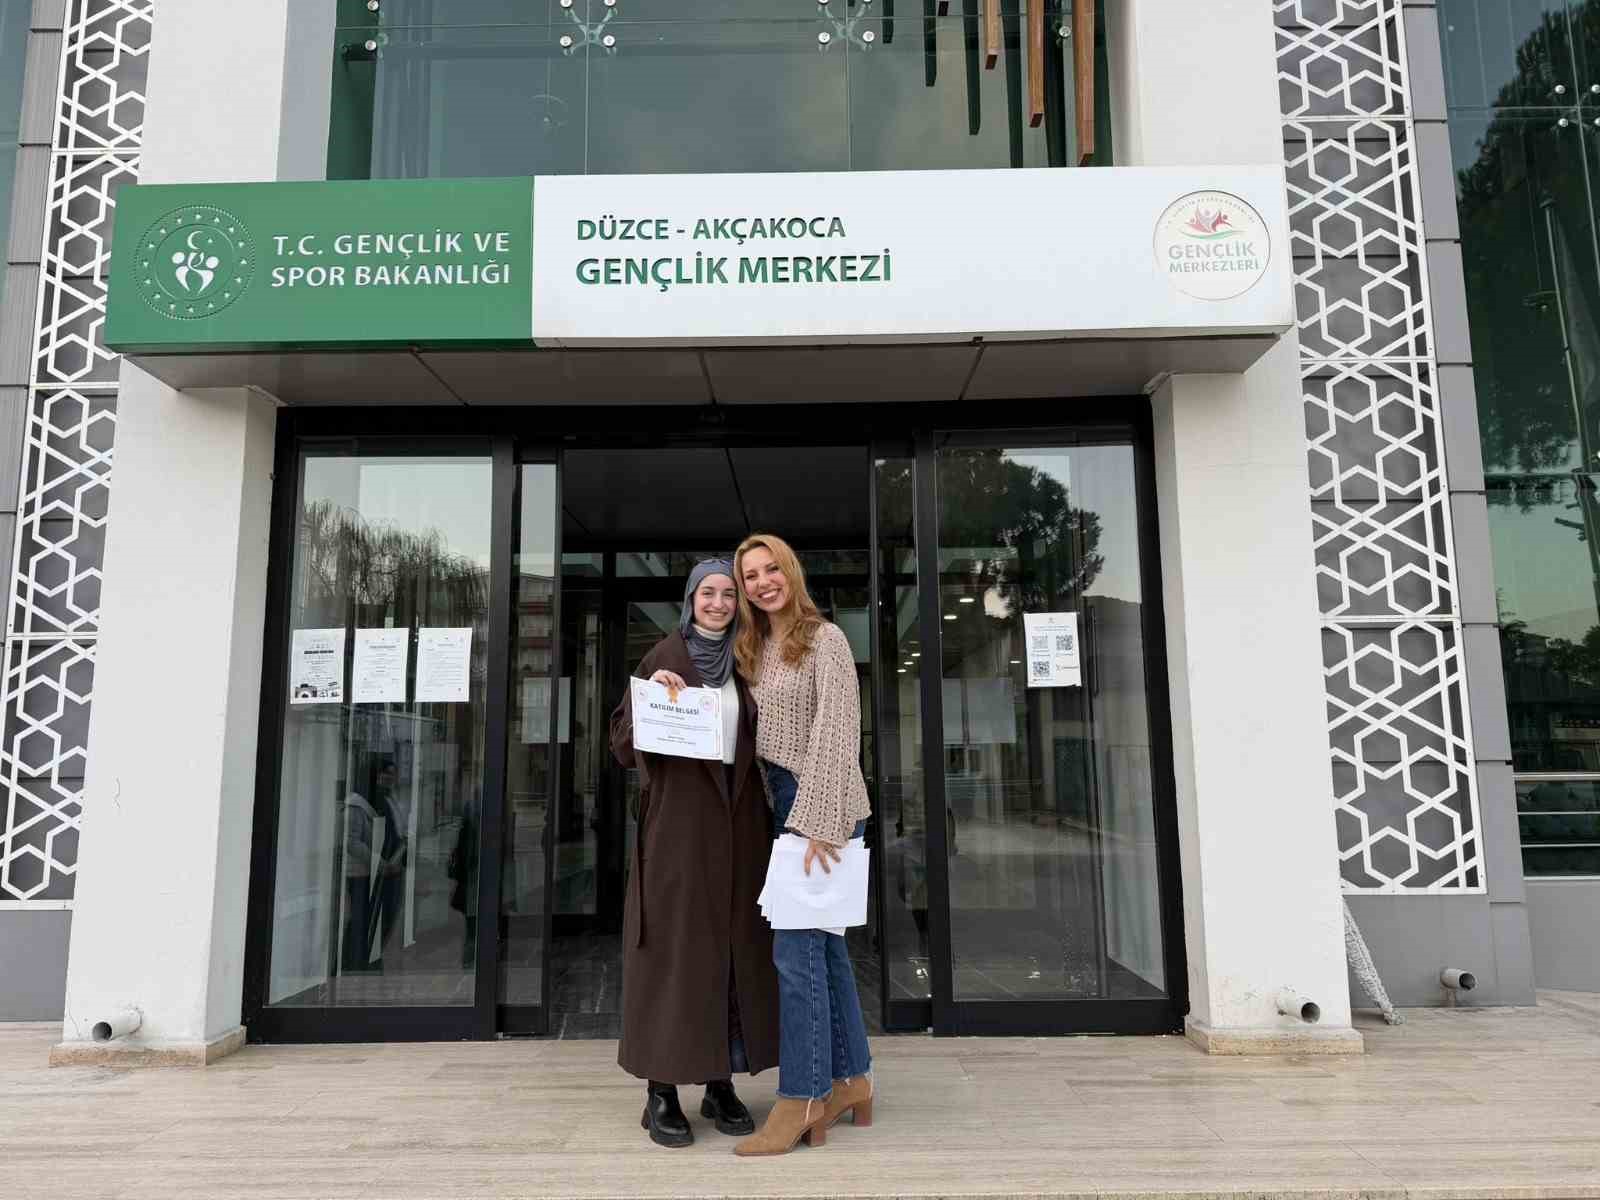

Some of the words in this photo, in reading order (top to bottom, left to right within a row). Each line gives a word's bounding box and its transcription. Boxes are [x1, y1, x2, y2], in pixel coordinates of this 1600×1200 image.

[272, 235, 323, 256] T.C.
[333, 229, 462, 259] GENÇLİK
[473, 232, 510, 253] VE
[576, 214, 670, 241] DÜZCE
[692, 217, 846, 245] AKÇAKOCA
[1168, 240, 1256, 260] GENÇLİK
[271, 265, 345, 288] SPOR
[354, 259, 510, 286] BAKANLIĞI
[575, 250, 729, 292] GENÇLİK
[738, 248, 891, 284] MERKEZİ
